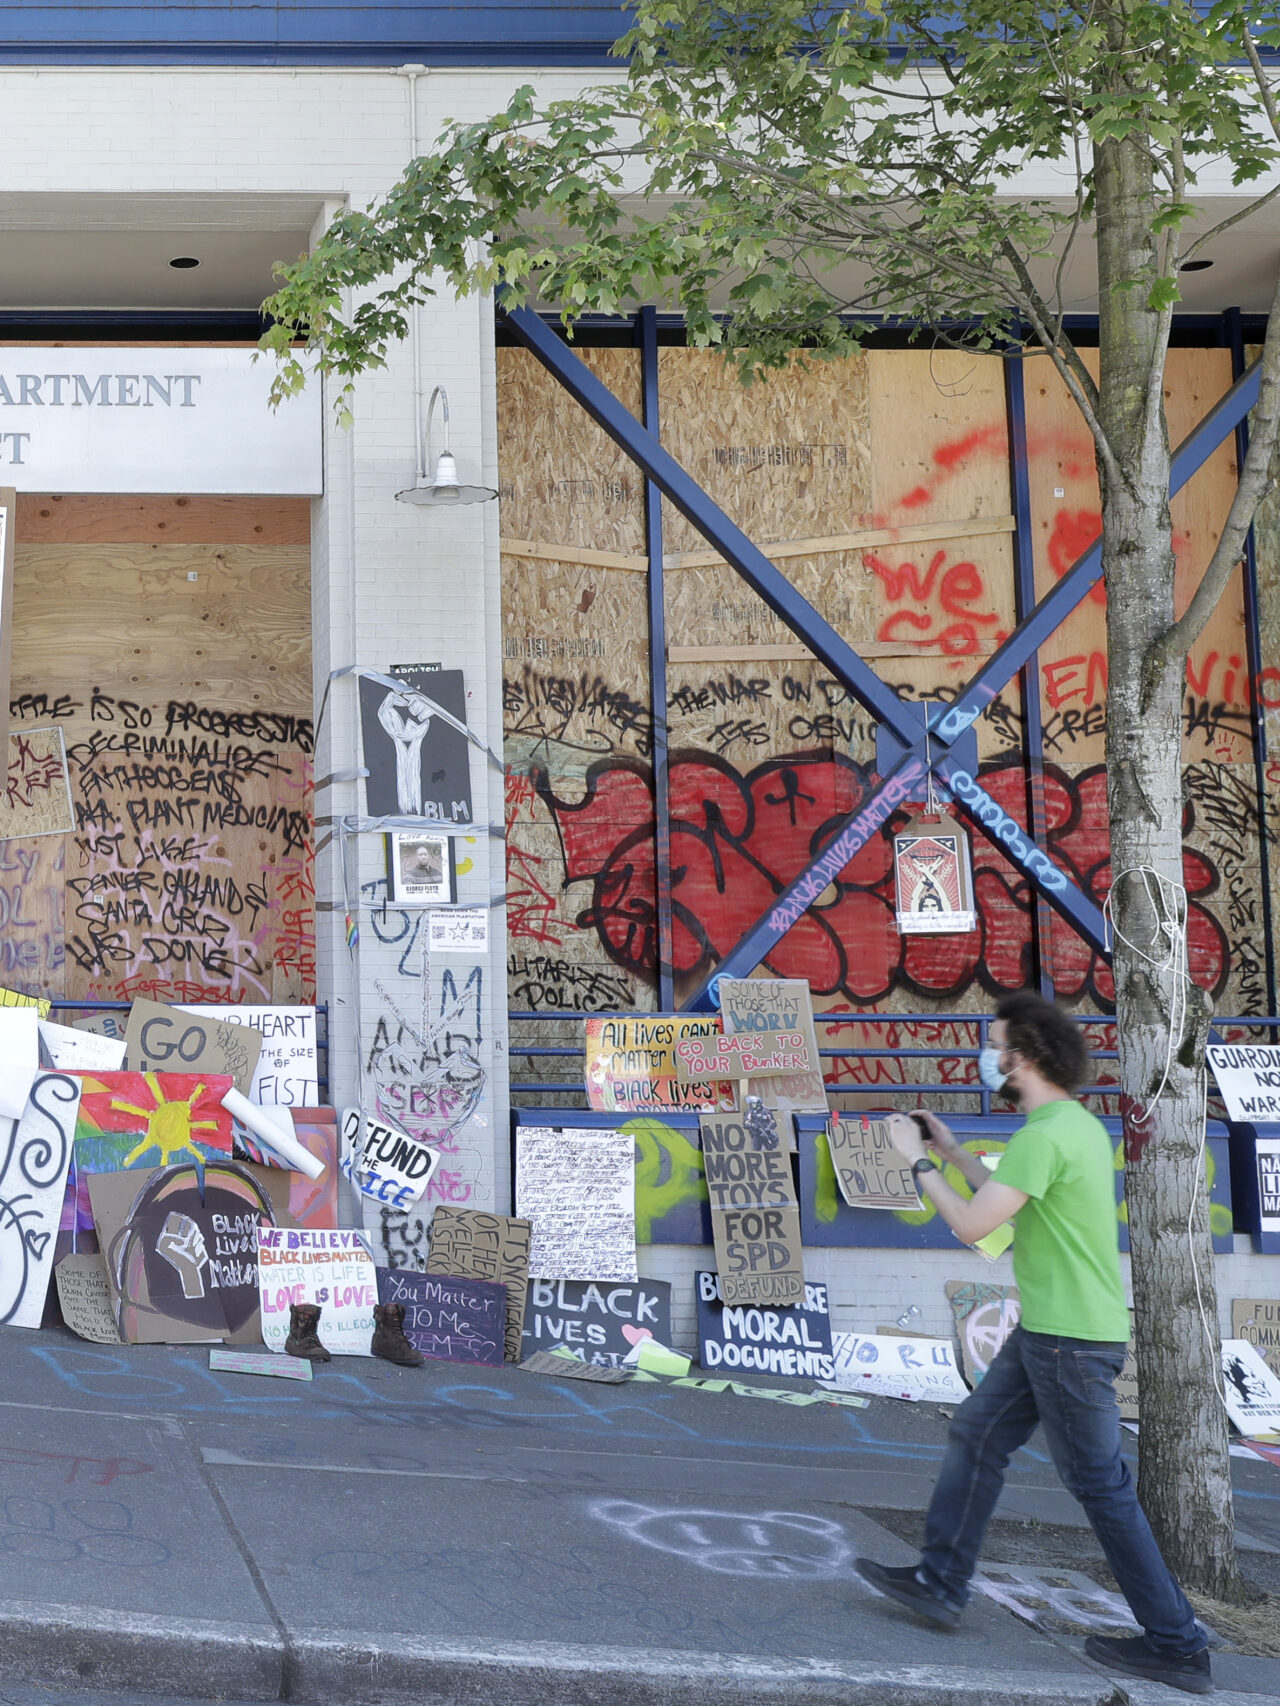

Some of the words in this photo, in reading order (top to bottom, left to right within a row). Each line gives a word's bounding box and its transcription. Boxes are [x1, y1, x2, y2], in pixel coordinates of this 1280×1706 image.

[667, 685, 715, 717] THE
[709, 674, 772, 706] WAR
[781, 676, 811, 701] ON
[120, 700, 152, 729] SO
[128, 797, 200, 831] PLANT
[424, 800, 470, 821] BLM
[77, 834, 125, 867] JUST
[136, 837, 211, 868] LIKE
[162, 868, 244, 915] OAKLAND
[76, 899, 153, 933] SANTA
[730, 980, 768, 998] SOME
[770, 981, 786, 998] OF
[727, 998, 767, 1012] THOSE
[768, 998, 801, 1012] THAT
[249, 1014, 312, 1038] HEART
[633, 1022, 672, 1046] lives
[140, 1016, 207, 1062] GO
[676, 1040, 704, 1057] GO
[717, 1035, 763, 1053] BACK
[776, 1034, 803, 1049] TO
[260, 1048, 283, 1058] THE
[290, 1047, 314, 1058] SIZE
[686, 1055, 729, 1076] YOUR
[258, 1075, 317, 1107] FIST
[669, 1079, 712, 1103] lives
[702, 1124, 747, 1153] NO
[705, 1152, 788, 1182] MORE
[850, 1151, 885, 1167] THE
[840, 1168, 917, 1196] POLICE
[710, 1182, 789, 1210] TOYS
[212, 1214, 259, 1234] BLACK
[724, 1212, 787, 1242] FOR
[216, 1236, 258, 1255] Lives
[257, 1228, 283, 1248] WE
[287, 1231, 364, 1249] BELIEVE
[260, 1249, 300, 1265] BLACK
[302, 1251, 331, 1264] LIVES
[331, 1250, 373, 1263] MATTER
[57, 1276, 81, 1287] THOSE
[83, 1279, 104, 1288] THAT
[60, 1264, 87, 1279] SOME
[89, 1271, 102, 1279] OF
[261, 1267, 304, 1283] WATER
[313, 1267, 325, 1282] IS
[332, 1266, 368, 1281] LIFE
[62, 1286, 82, 1297] BURN
[262, 1284, 308, 1313] LOVE
[315, 1288, 329, 1303] IS
[334, 1285, 377, 1307] LOVE
[390, 1276, 418, 1303] You
[425, 1282, 495, 1312] Matter
[723, 1276, 802, 1299] DEFUND
[66, 1301, 90, 1314] SAME
[91, 1307, 112, 1316] THAT
[84, 1298, 99, 1306] THE
[532, 1278, 659, 1322] BLACK
[72, 1321, 97, 1332] BLACK
[75, 1313, 100, 1325] HOLD
[264, 1327, 281, 1338] NO
[323, 1321, 333, 1333] IS
[723, 1306, 823, 1347] MORAL
[404, 1330, 452, 1355] BLM
[705, 1340, 835, 1379] DOCUMENTS
[897, 1344, 925, 1370] R
[931, 1346, 952, 1366] U
